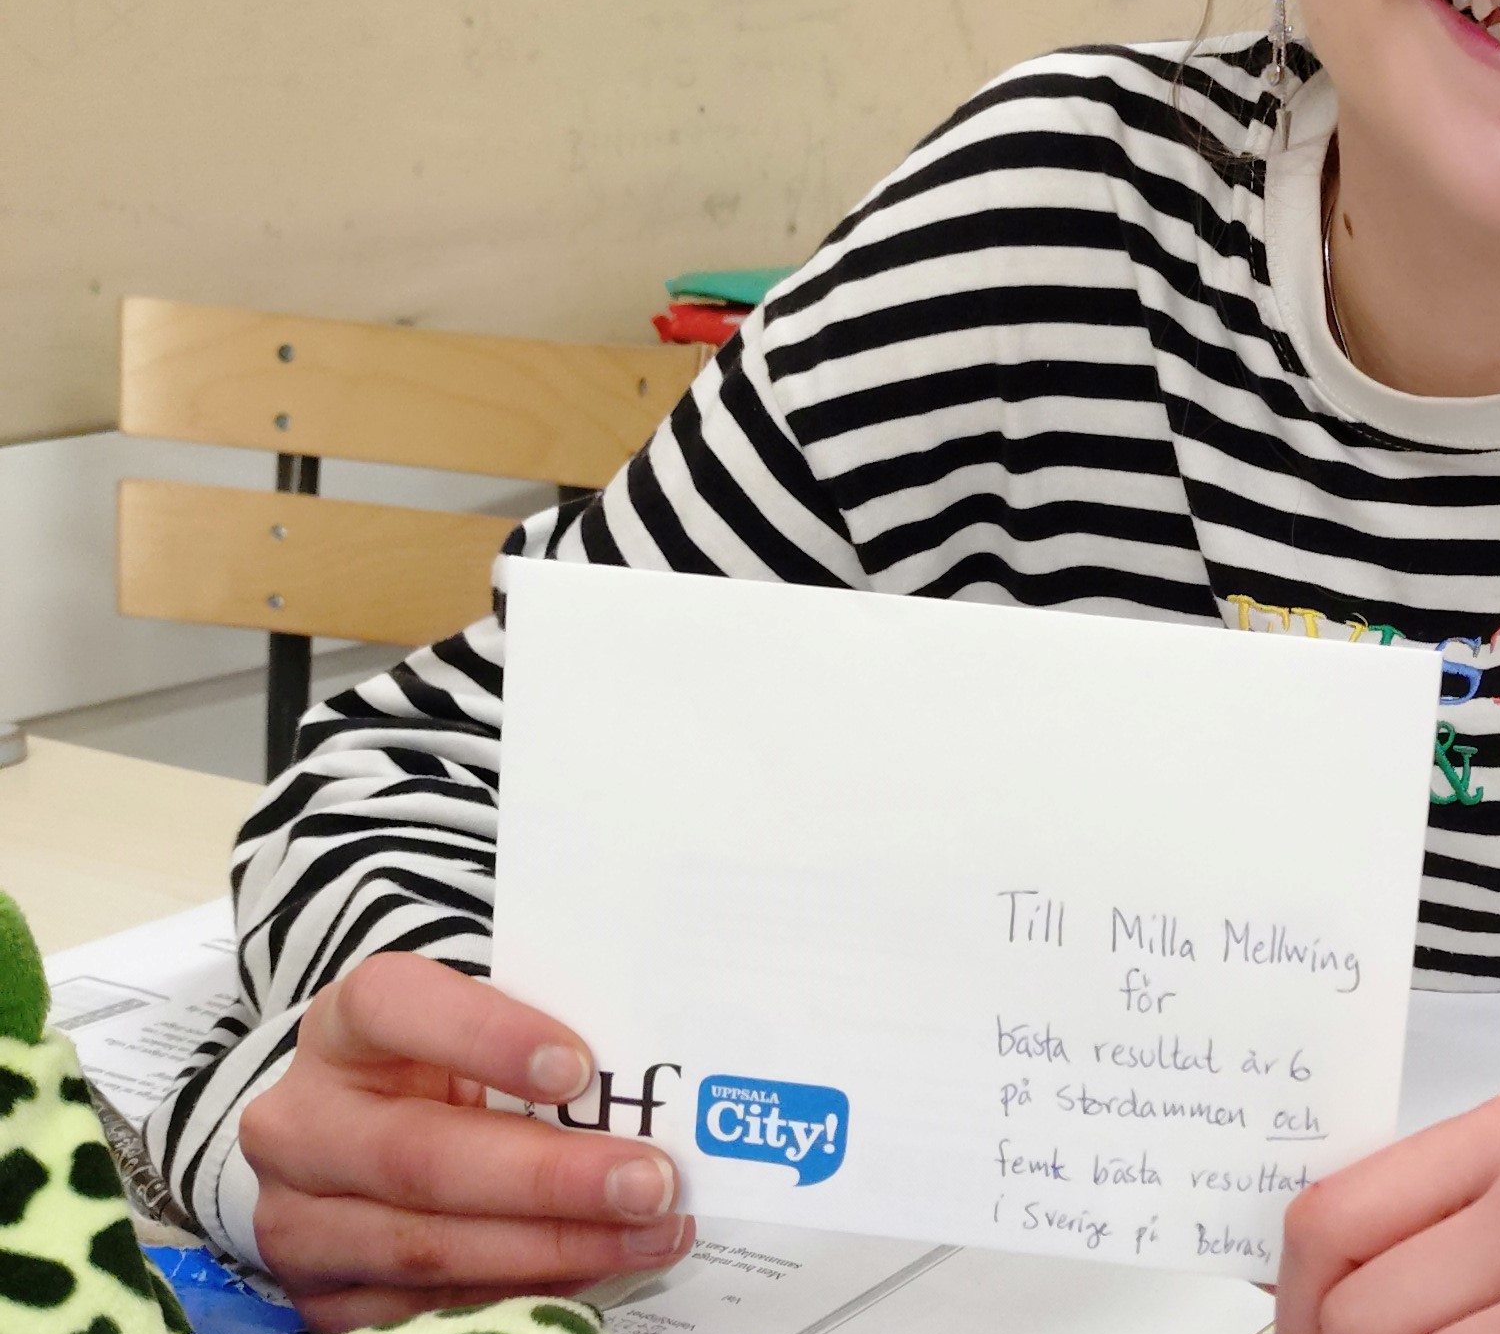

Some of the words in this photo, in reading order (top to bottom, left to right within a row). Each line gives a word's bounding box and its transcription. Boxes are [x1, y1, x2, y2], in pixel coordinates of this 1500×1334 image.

[1430, 720, 1483, 806] &
[997, 889, 1066, 948] Till
[1111, 906, 1197, 963] Milla
[1222, 917, 1362, 994] Mellwing
[1119, 967, 1178, 1015] för
[997, 1014, 1070, 1065] bästa
[1093, 1034, 1225, 1075] resultat
[1240, 1047, 1280, 1078] år
[1289, 1048, 1313, 1082] 6
[711, 1085, 781, 1106] UPPSALA
[1000, 1077, 1034, 1118] på
[1271, 1105, 1322, 1137] och
[706, 1100, 840, 1162] City!
[1093, 1149, 1163, 1187] bästa
[993, 1192, 1006, 1223] i
[1022, 1199, 1113, 1250] Sverige
[705, 1242, 730, 1255] kan
[731, 1260, 756, 1273] hur
[756, 1267, 787, 1281] Men
